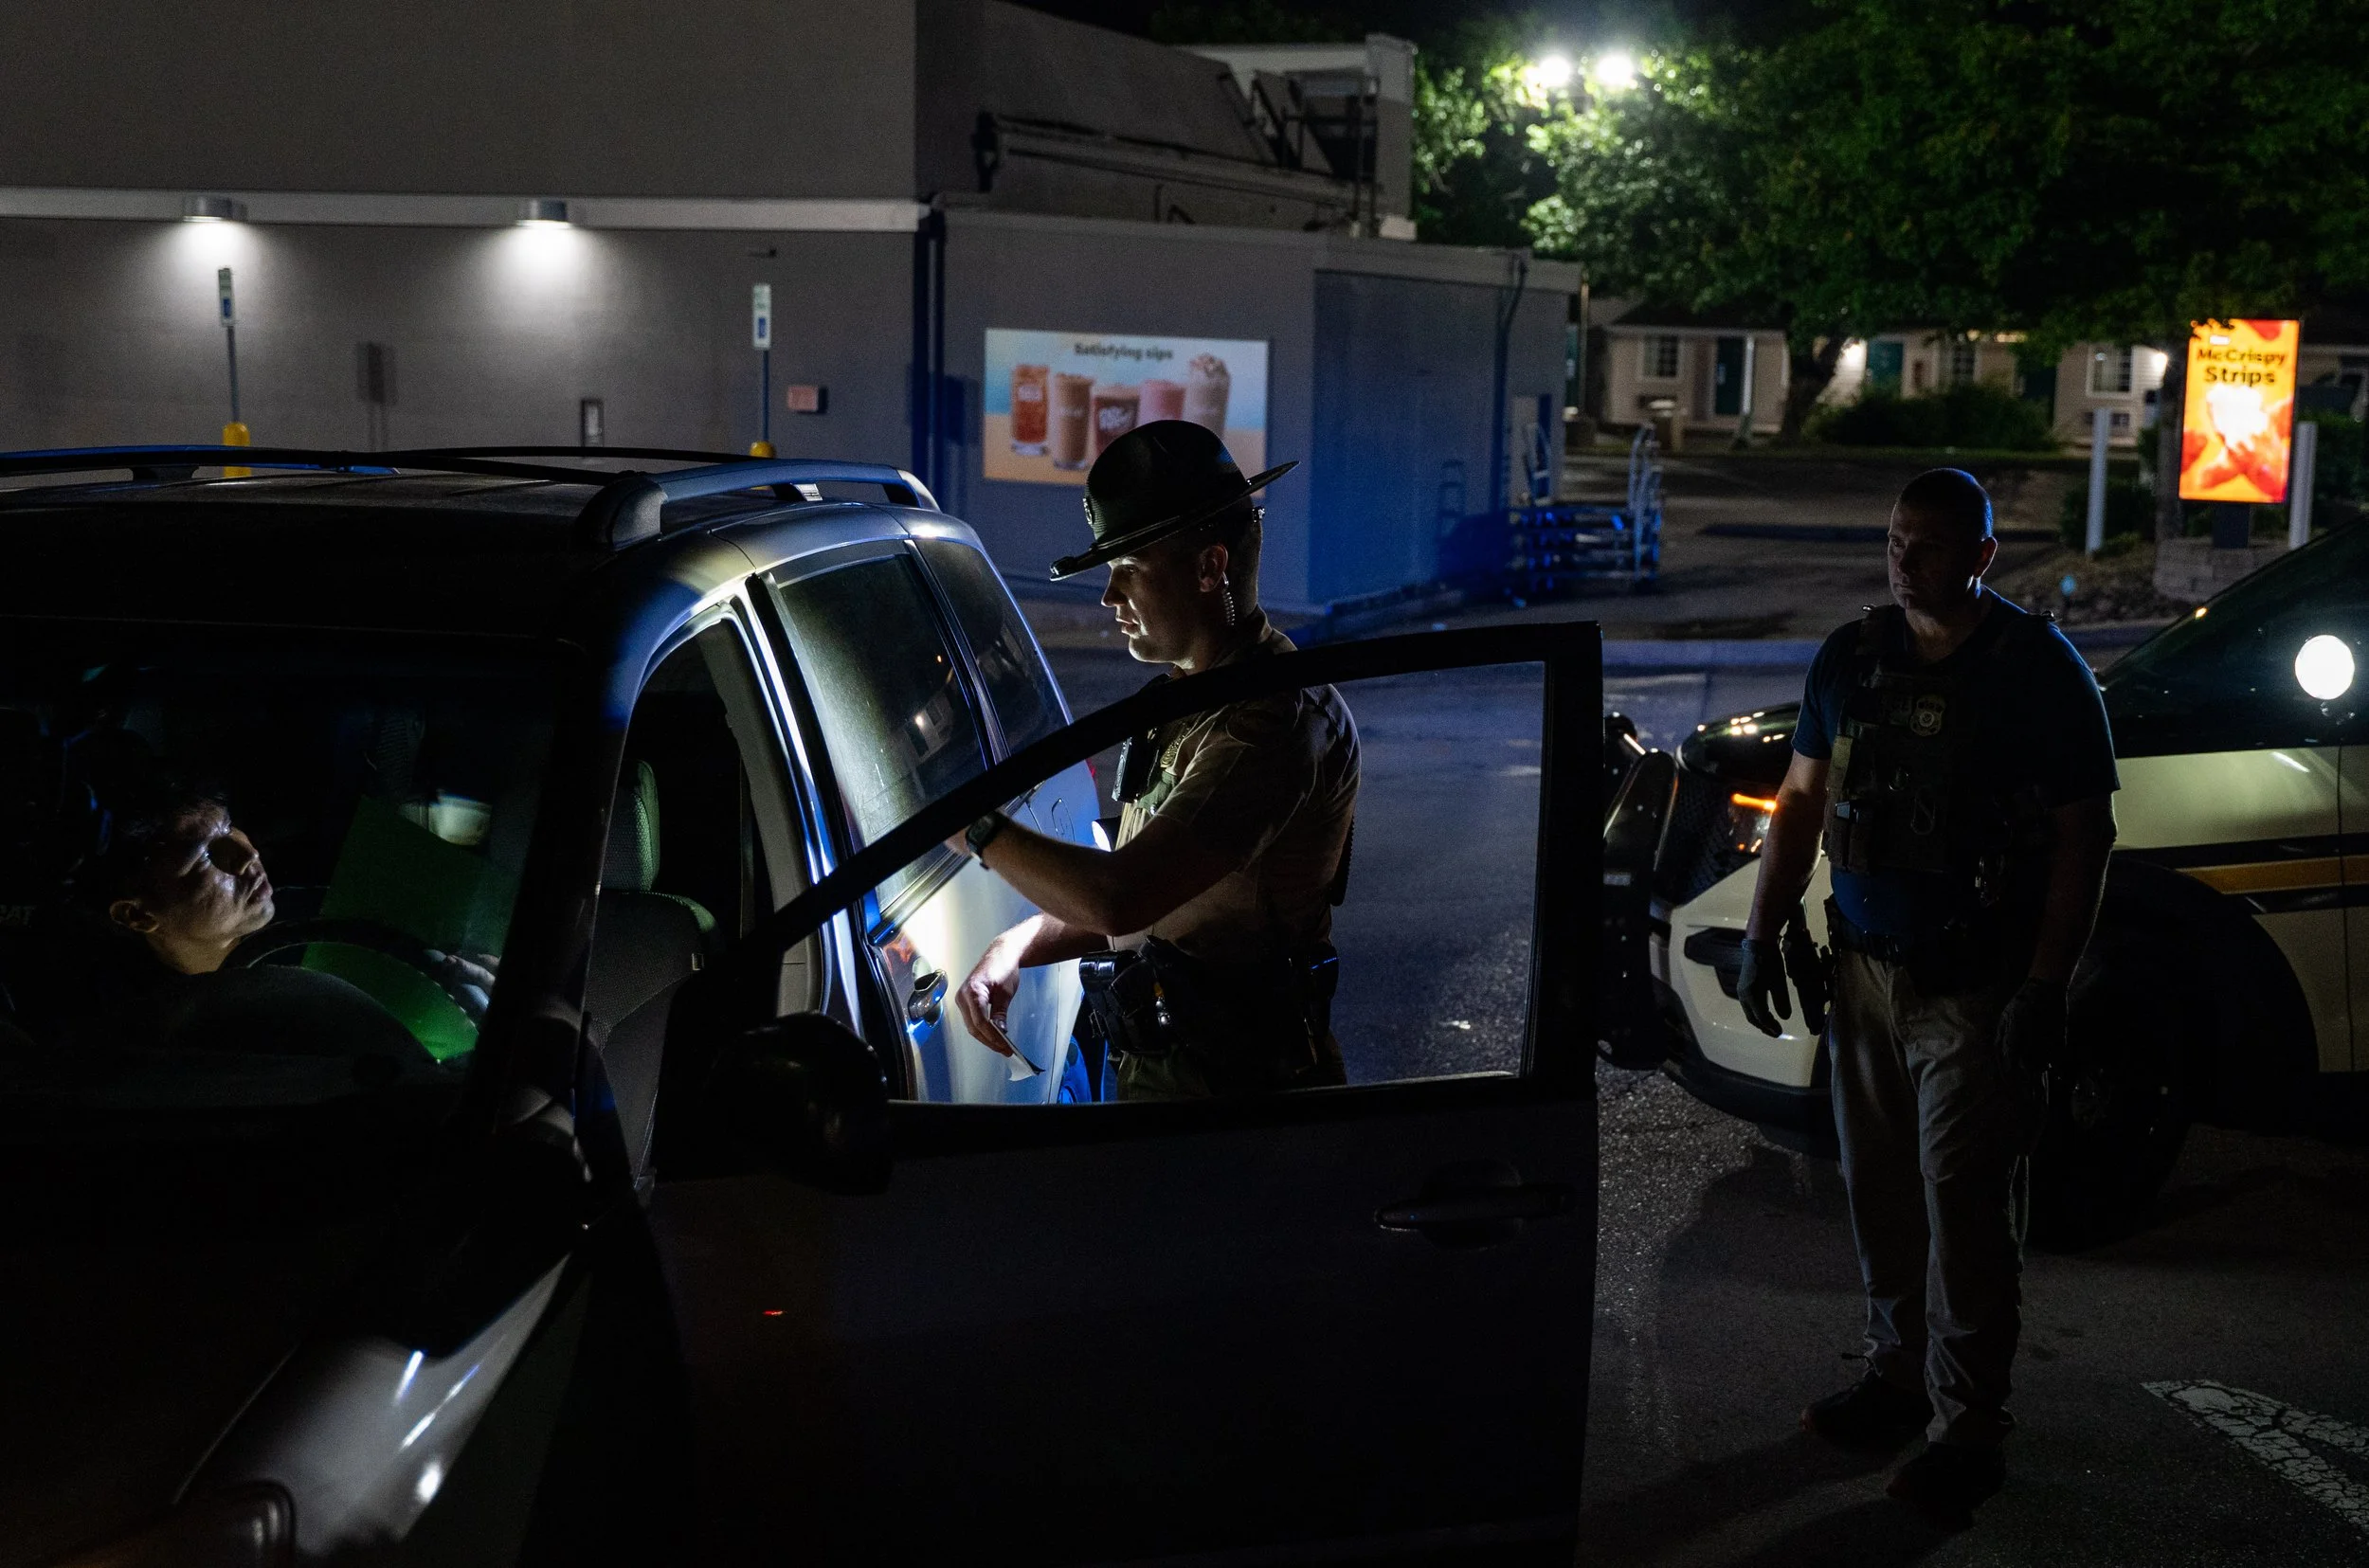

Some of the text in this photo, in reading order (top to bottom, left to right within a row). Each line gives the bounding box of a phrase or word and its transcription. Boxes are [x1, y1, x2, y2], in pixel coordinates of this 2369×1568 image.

[1074, 342, 1173, 361] Satisfying sips
[2204, 366, 2276, 387] Strips
